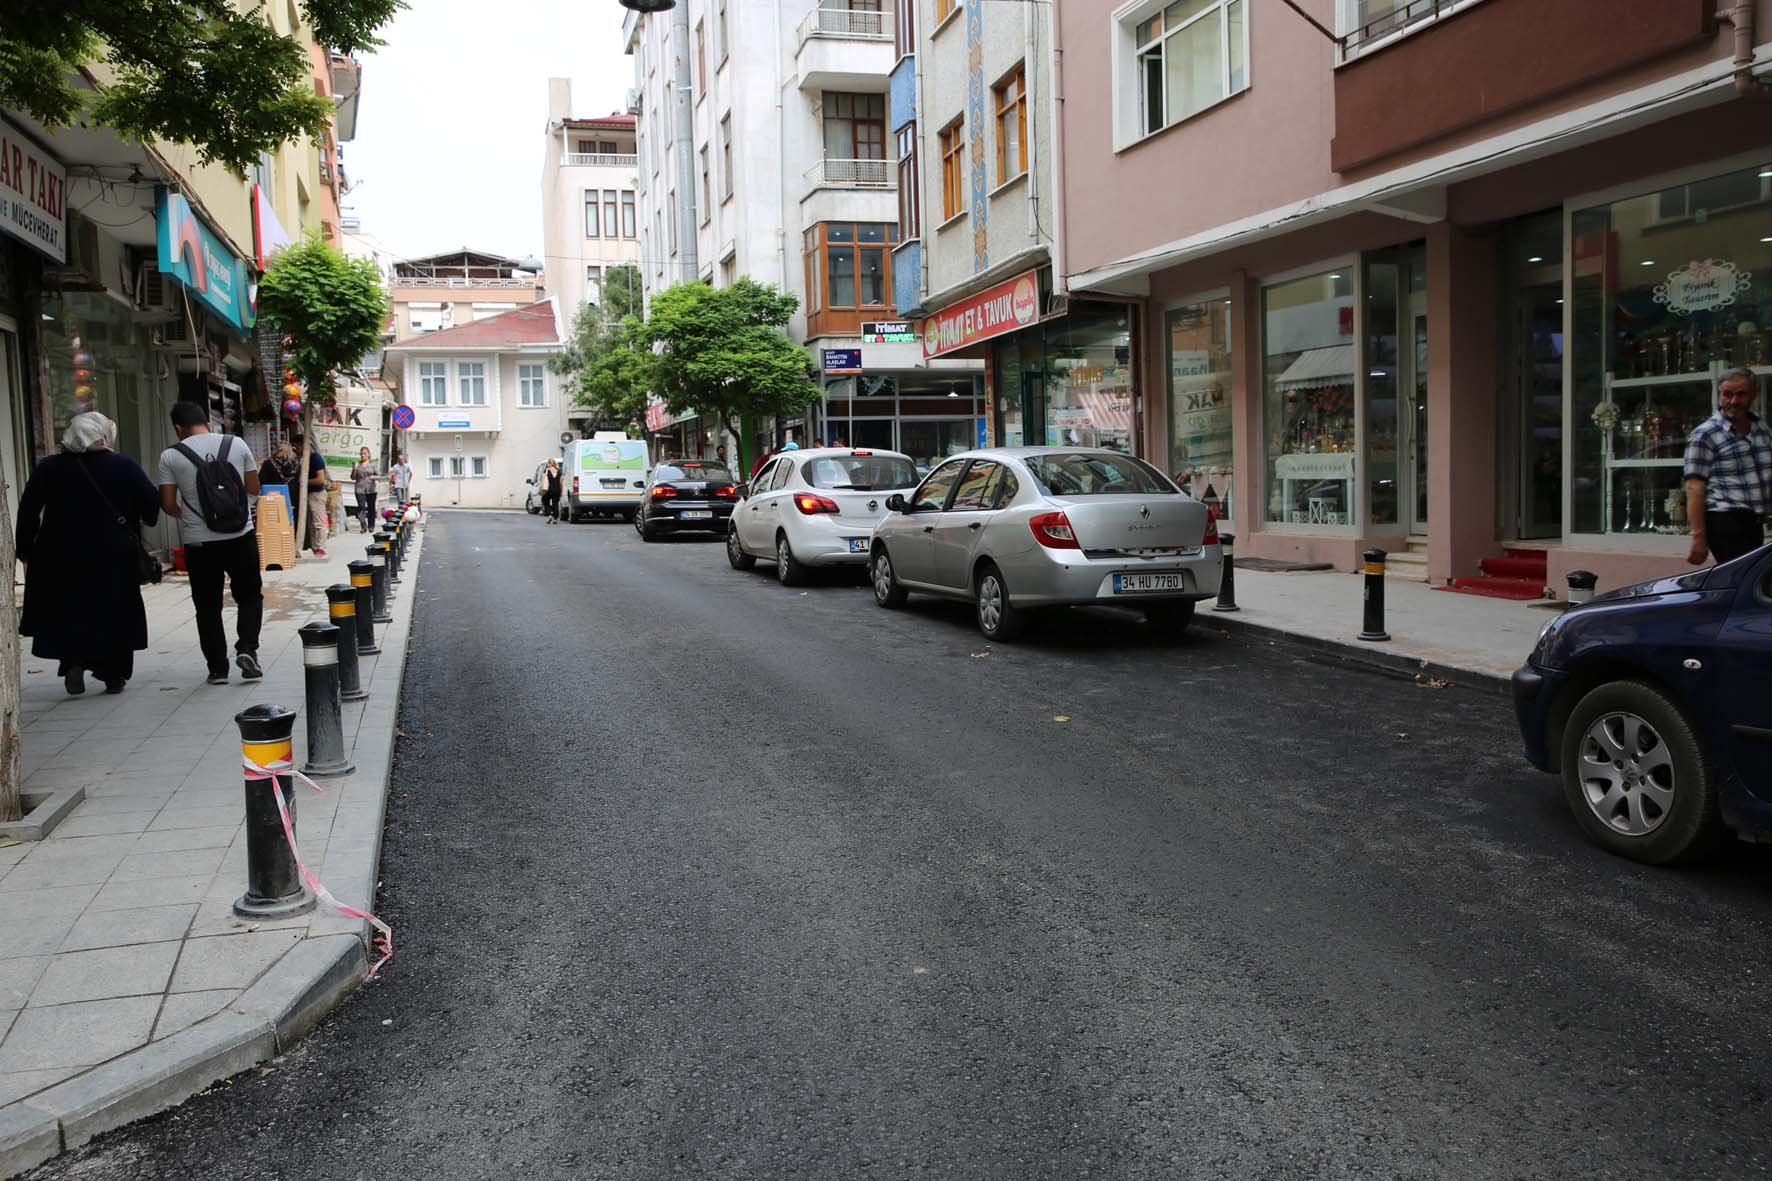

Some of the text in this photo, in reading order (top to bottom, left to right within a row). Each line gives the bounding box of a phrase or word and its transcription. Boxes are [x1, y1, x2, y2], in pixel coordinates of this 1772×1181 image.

[28, 155, 63, 221] TAKI
[12, 201, 58, 248] MÜCEVHERAT
[875, 322, 907, 333] İTİMAT
[965, 308, 975, 336] ET
[977, 305, 983, 331] &
[984, 293, 1013, 328] TAVUK
[317, 430, 364, 449] argo
[1122, 575, 1179, 588] 34 HU 7780
